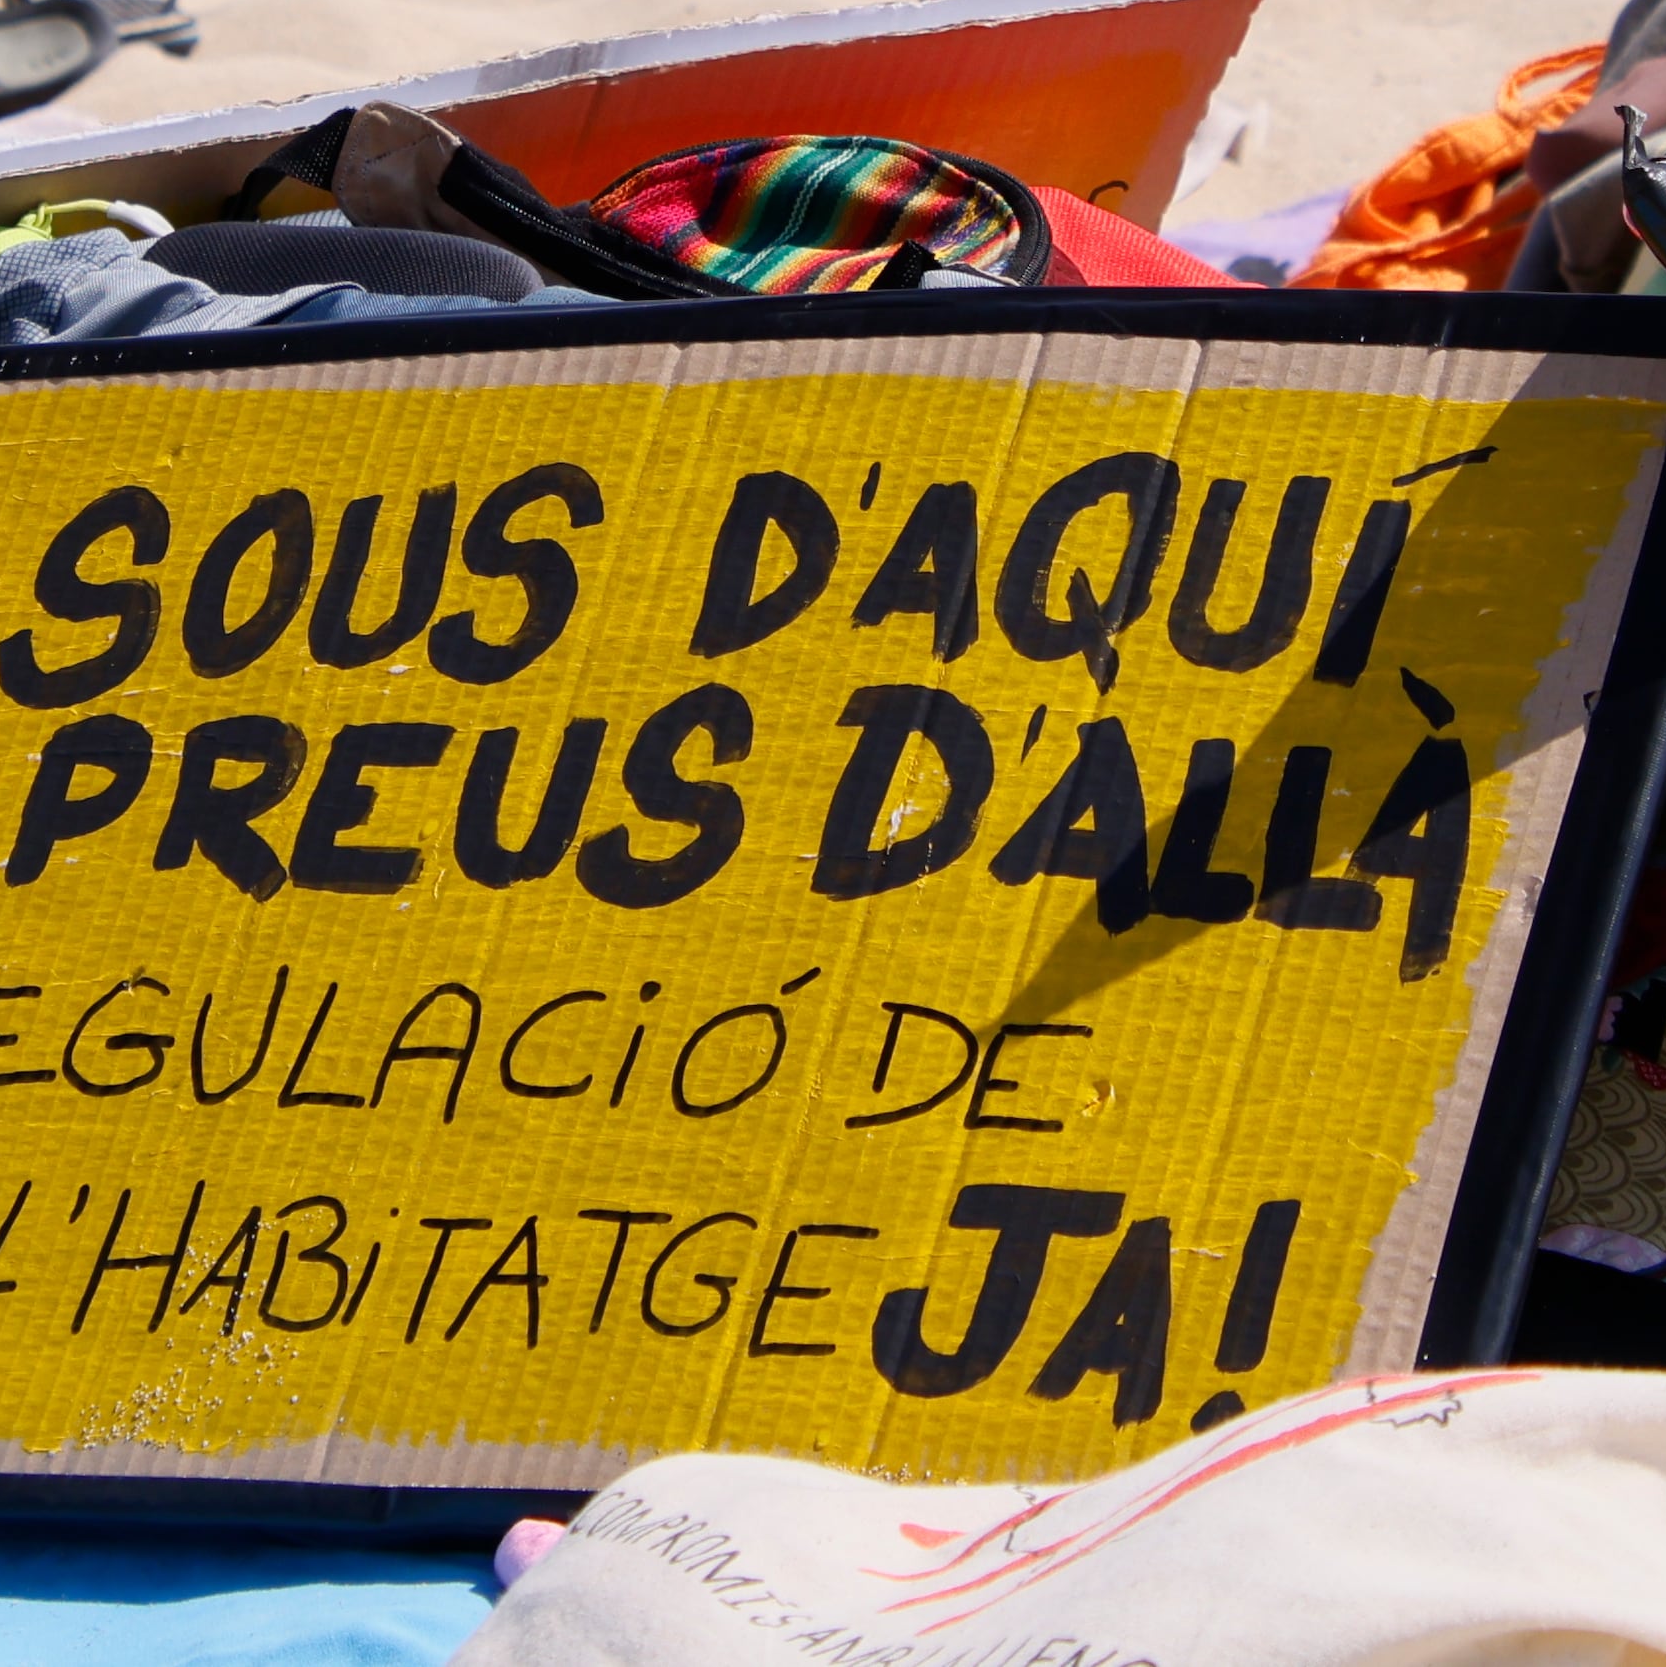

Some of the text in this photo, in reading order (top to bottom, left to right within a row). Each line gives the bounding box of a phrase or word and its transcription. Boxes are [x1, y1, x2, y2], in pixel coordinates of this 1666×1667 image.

[688, 445, 1498, 695] D'AQUÍ
[4, 666, 1472, 984] PREUS D'ALLÀ
[844, 1000, 1094, 1133] DE
[871, 1183, 1301, 1434] JA!
